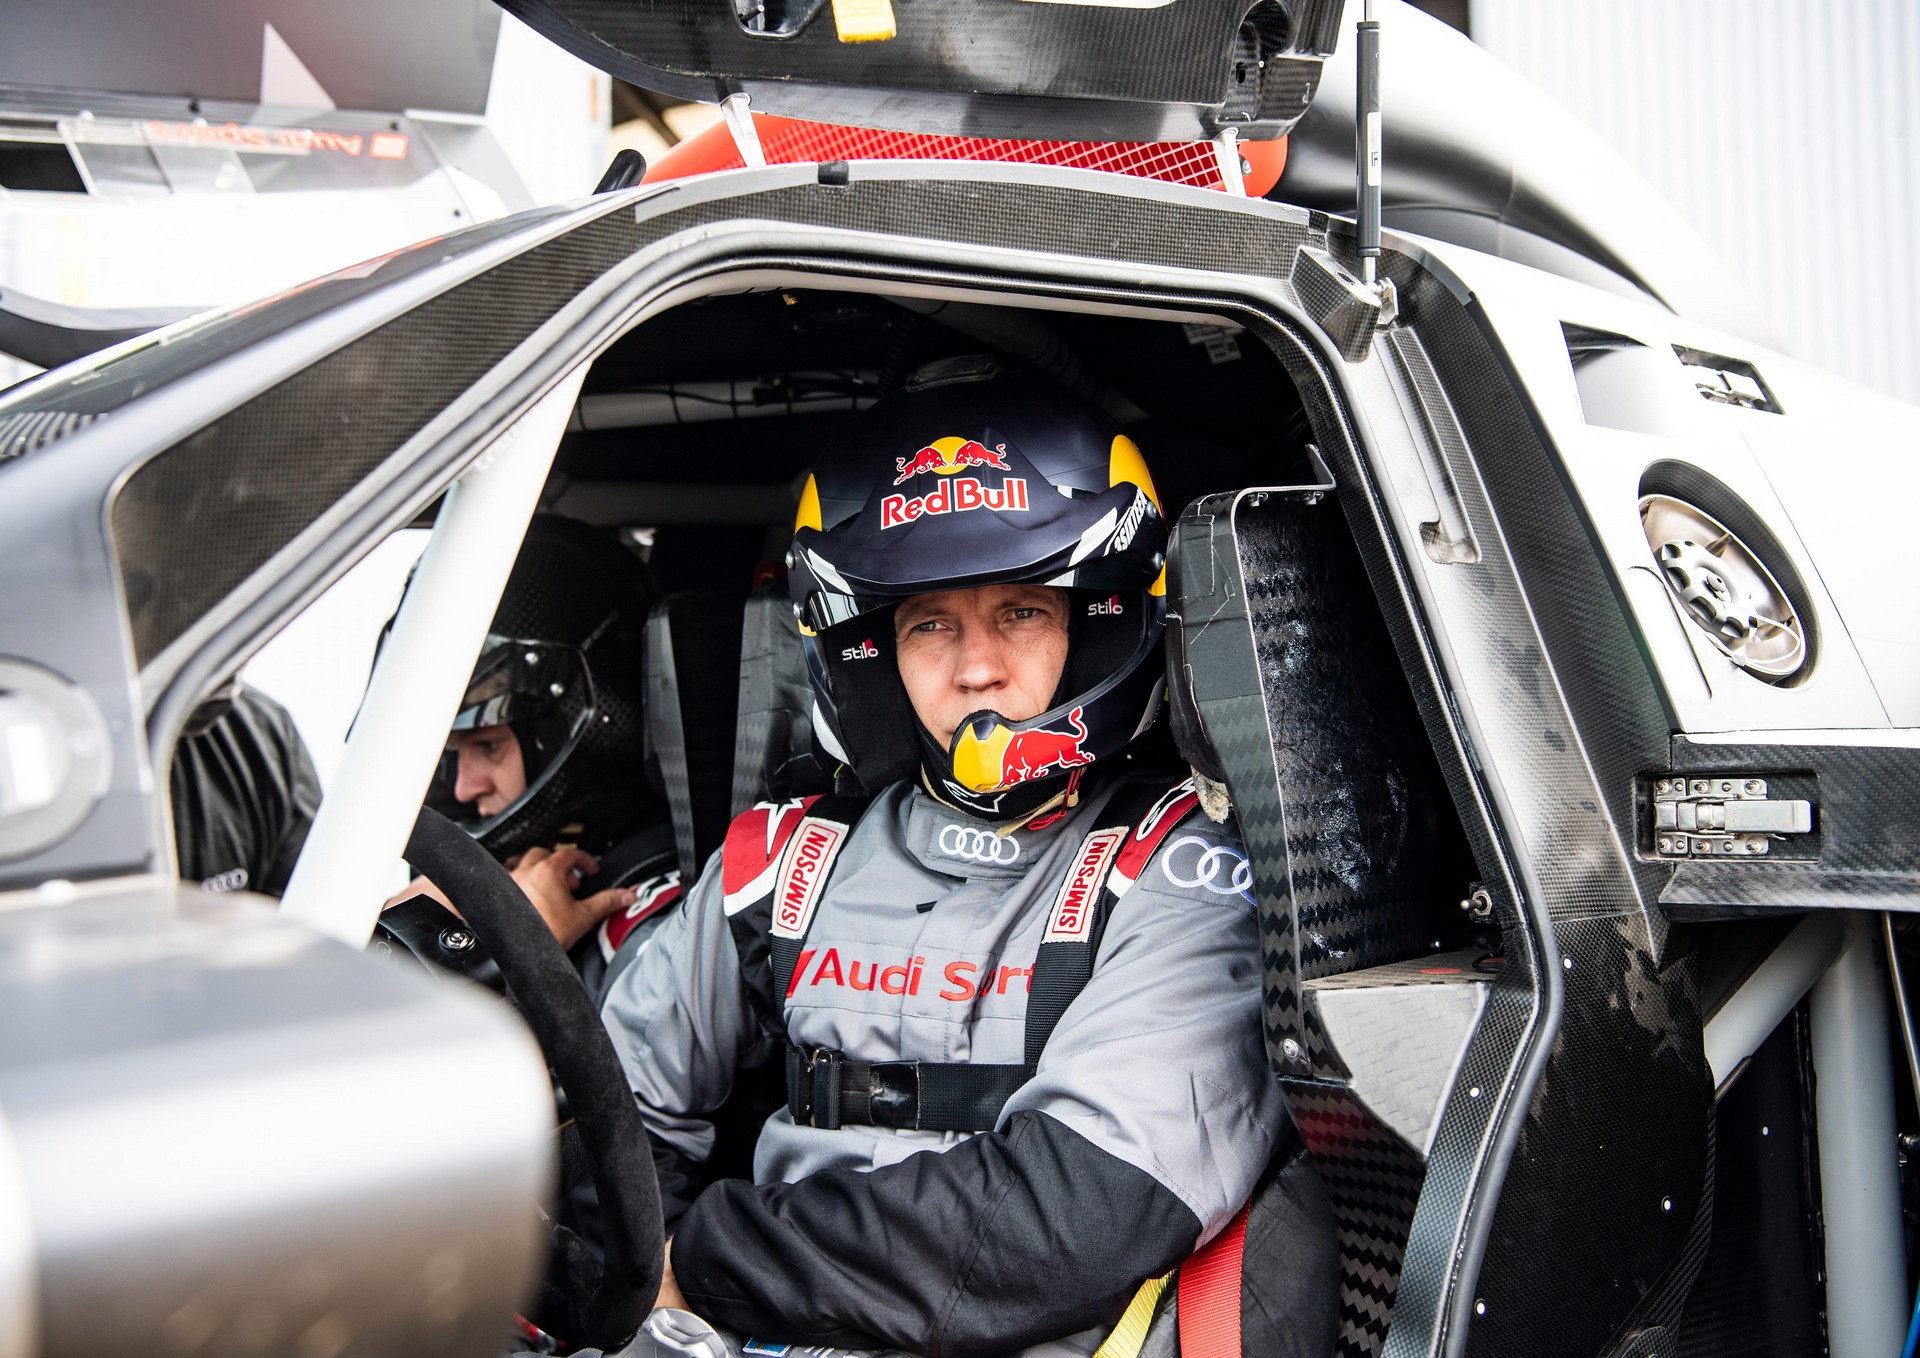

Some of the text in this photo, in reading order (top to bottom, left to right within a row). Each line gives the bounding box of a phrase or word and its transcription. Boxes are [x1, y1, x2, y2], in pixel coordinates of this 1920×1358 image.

[148, 121, 363, 157] Audi Sport
[882, 478, 1029, 529] Red Bull
[781, 831, 829, 925] SIMPSON
[1059, 842, 1109, 928] SIMPSON
[810, 948, 926, 996] Audi
